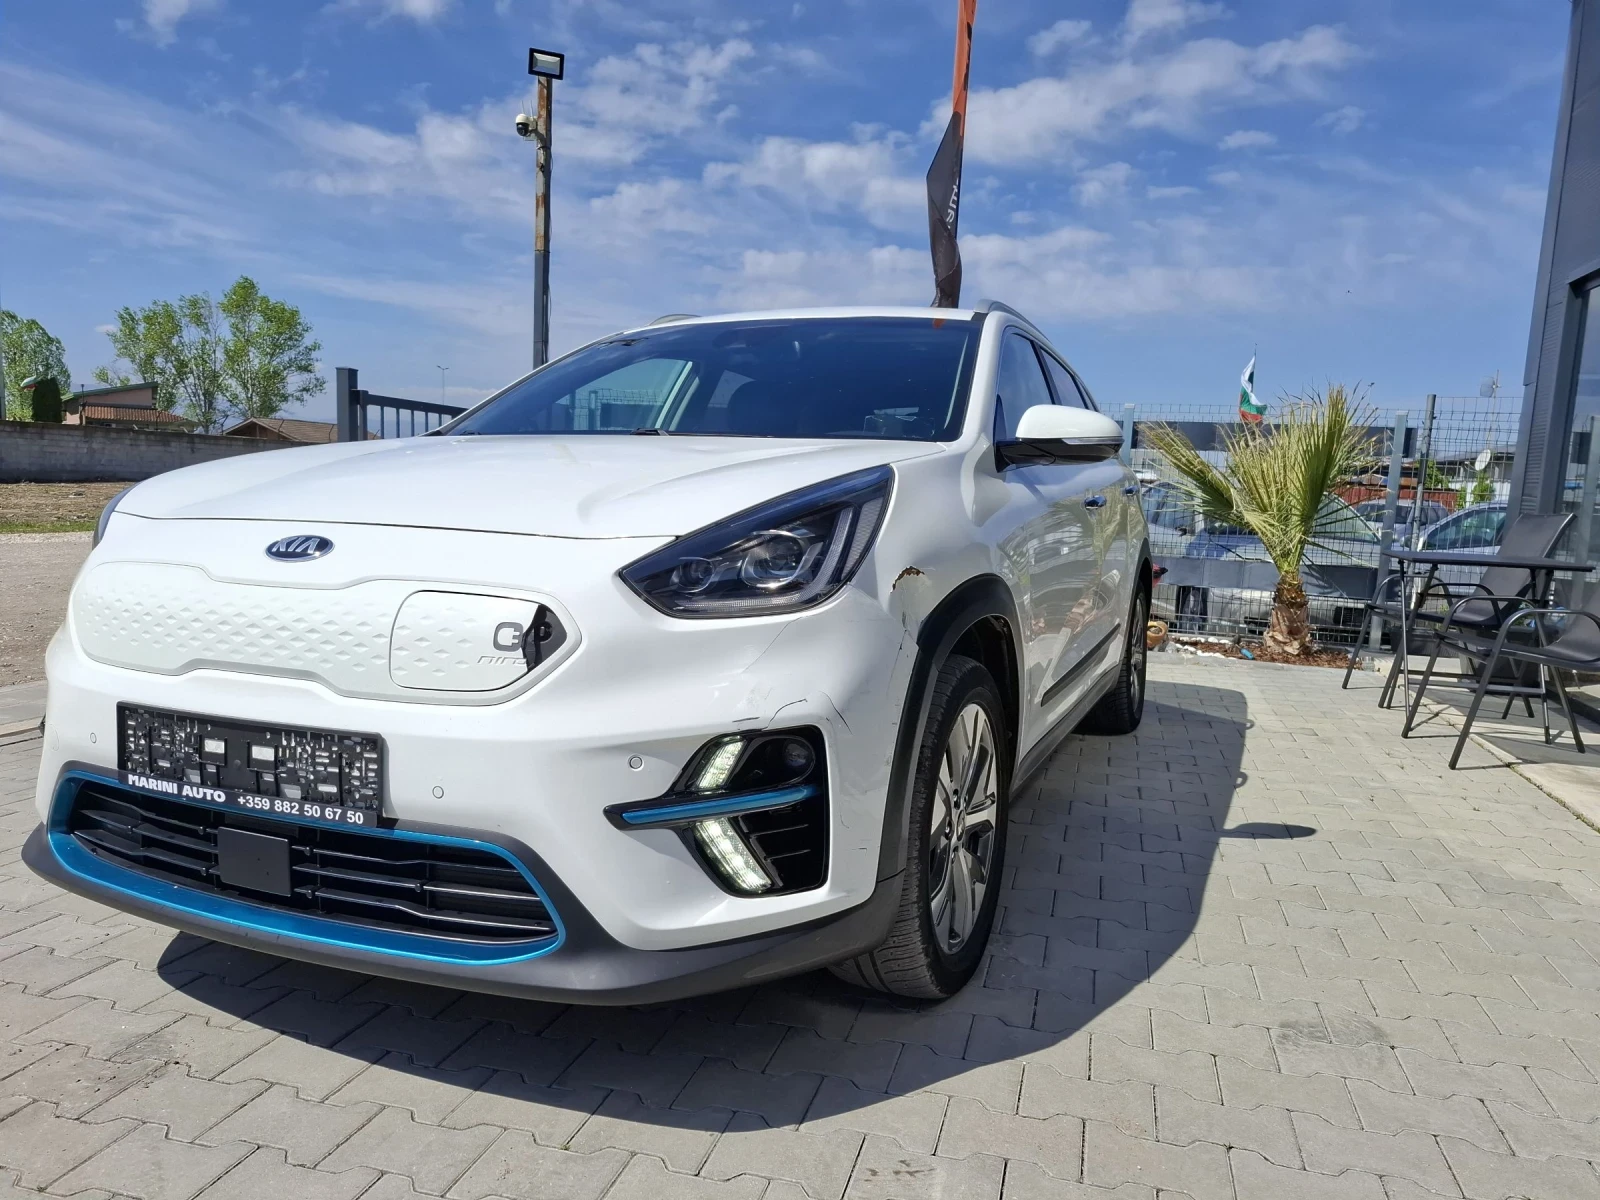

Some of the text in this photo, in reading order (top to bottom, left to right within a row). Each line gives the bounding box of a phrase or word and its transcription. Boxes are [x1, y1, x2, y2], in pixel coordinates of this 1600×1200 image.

[271, 536, 321, 554] KIA
[127, 774, 364, 825] MARINI AUTO +359 882 50 67 50
